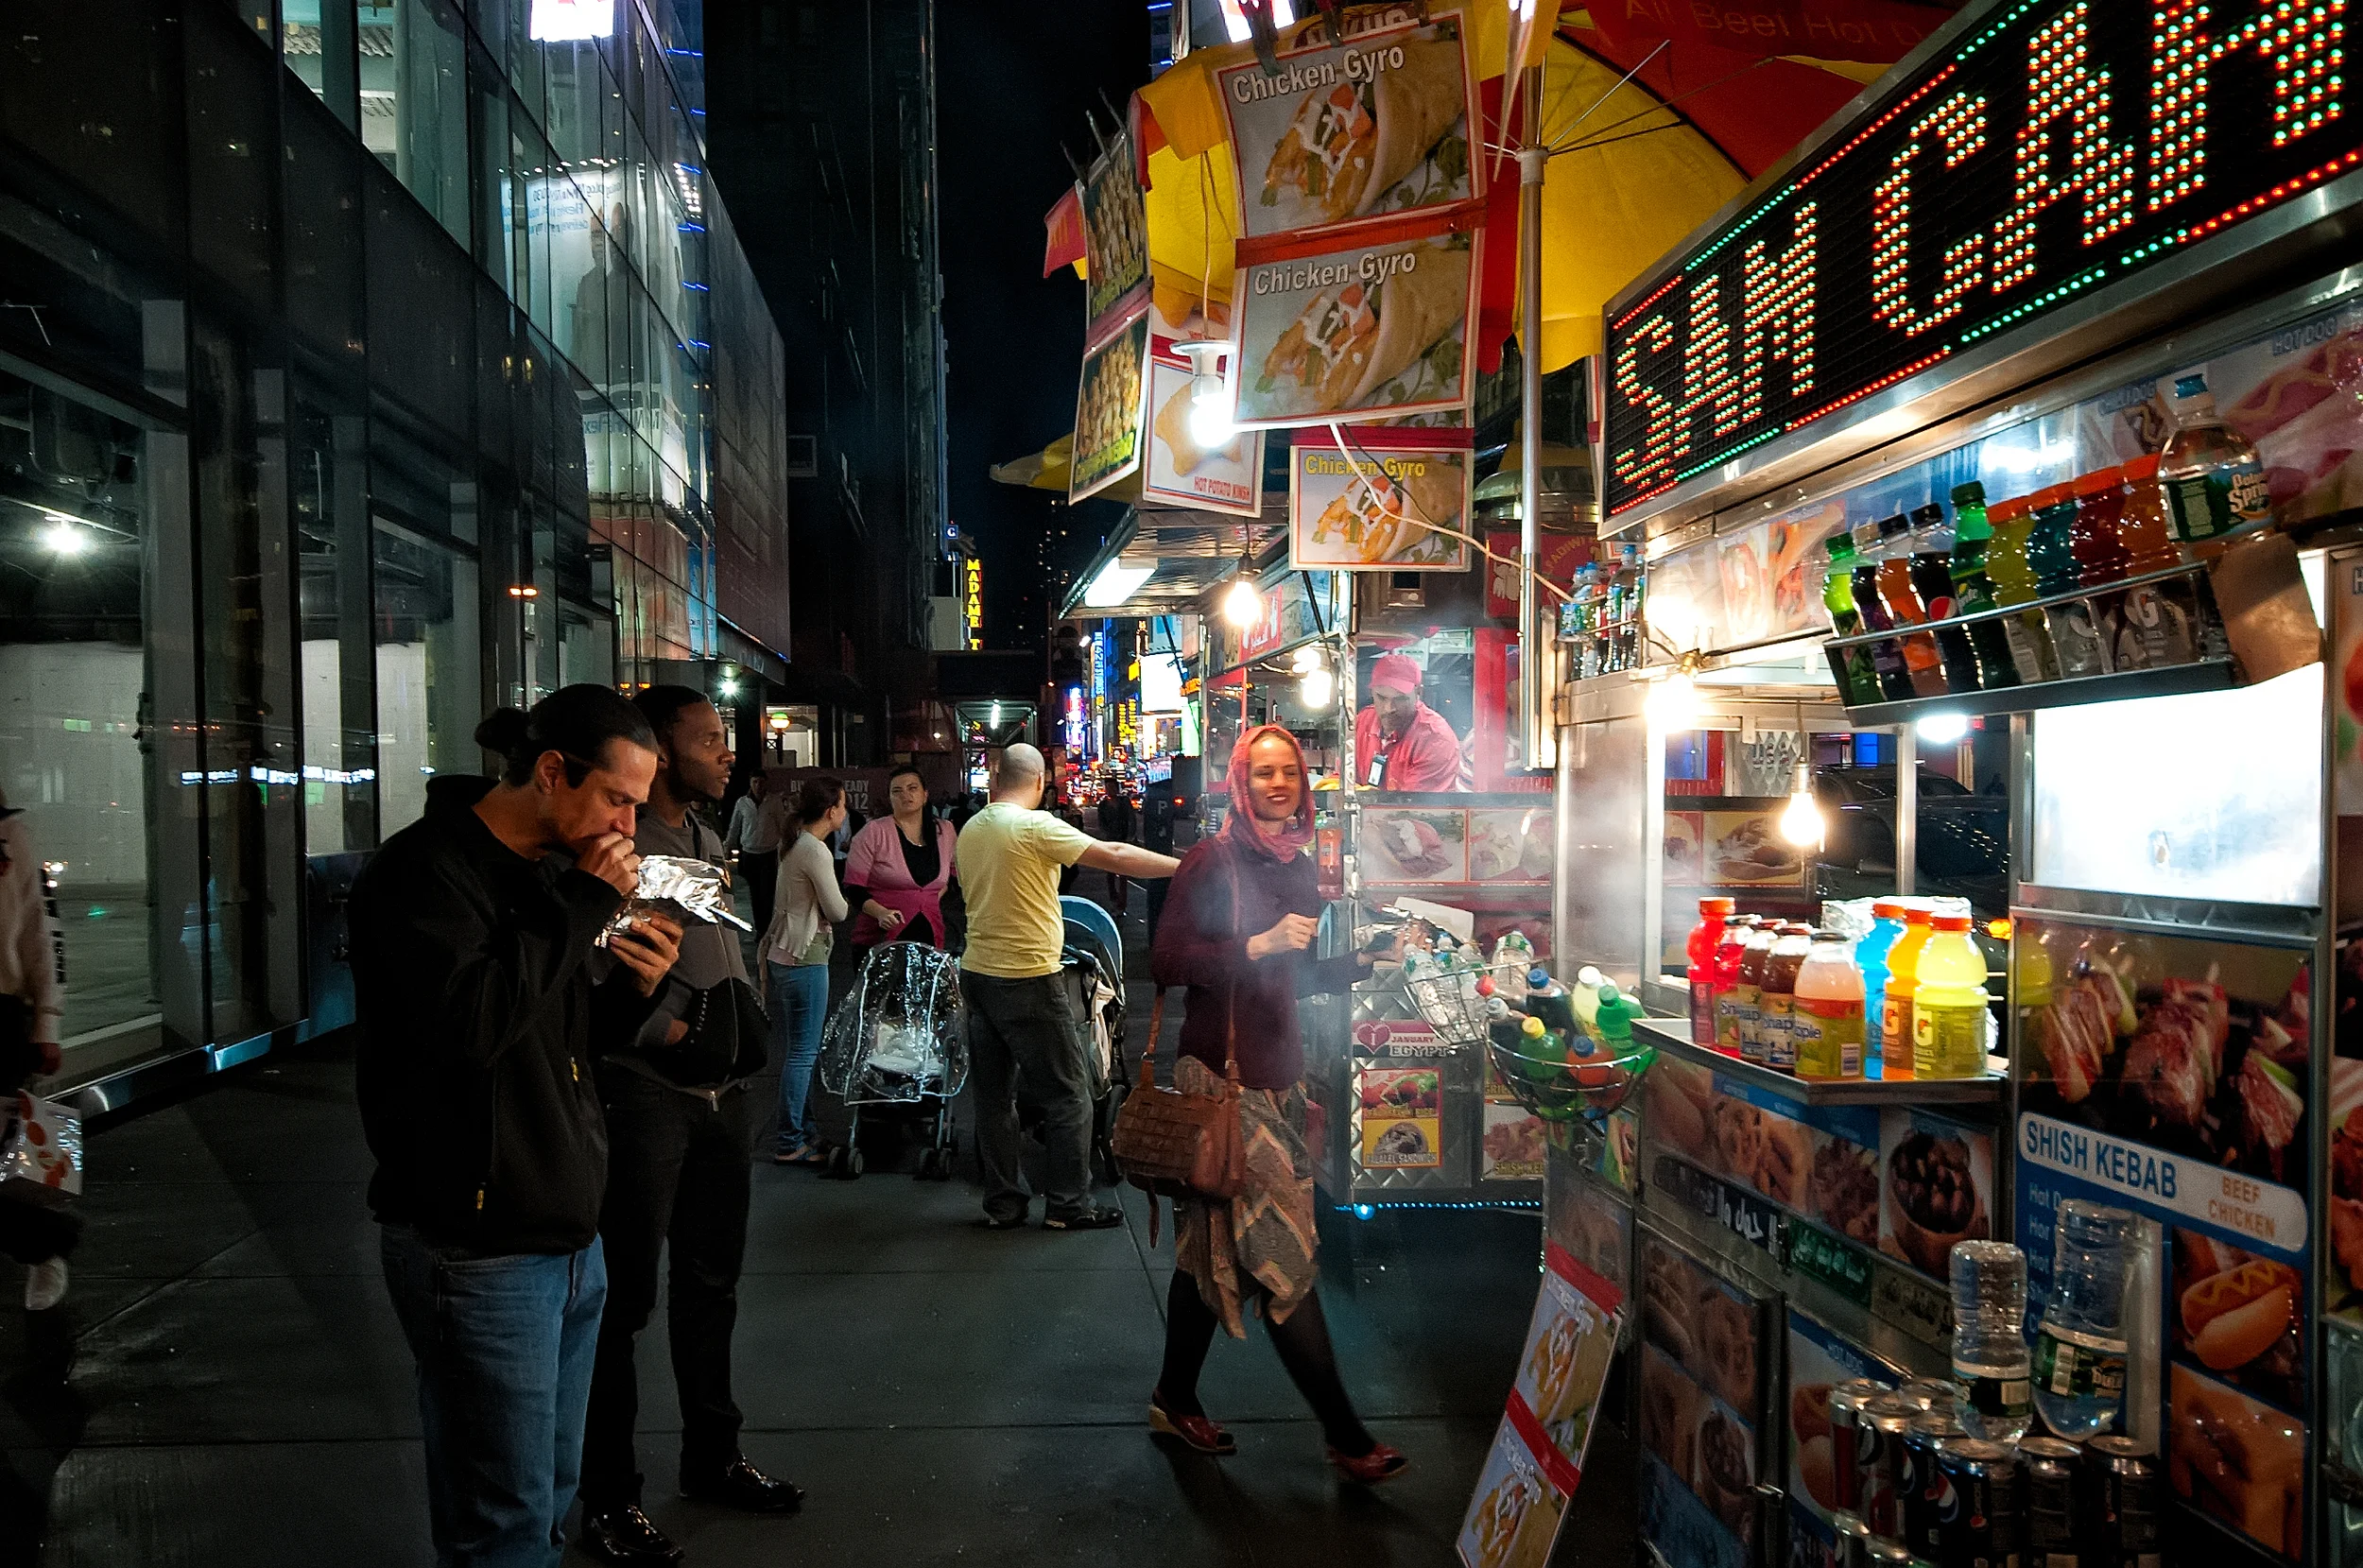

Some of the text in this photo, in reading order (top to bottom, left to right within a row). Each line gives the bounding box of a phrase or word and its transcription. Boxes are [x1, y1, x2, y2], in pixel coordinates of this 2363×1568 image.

[1233, 46, 1405, 103] Chicken Gyro
[1254, 252, 1416, 295] Chicken Gyro
[1615, 201, 1817, 489] SAM
[1384, 457, 1425, 481] Gyro
[967, 559, 981, 628] MADAME
[1914, 1010, 1933, 1046] G
[1389, 1045, 1449, 1057] EGYPT
[2027, 1121, 2177, 1198] SHISH KEBAB
[2222, 1176, 2261, 1203] BEEF
[2208, 1199, 2276, 1238] CHICKEN
